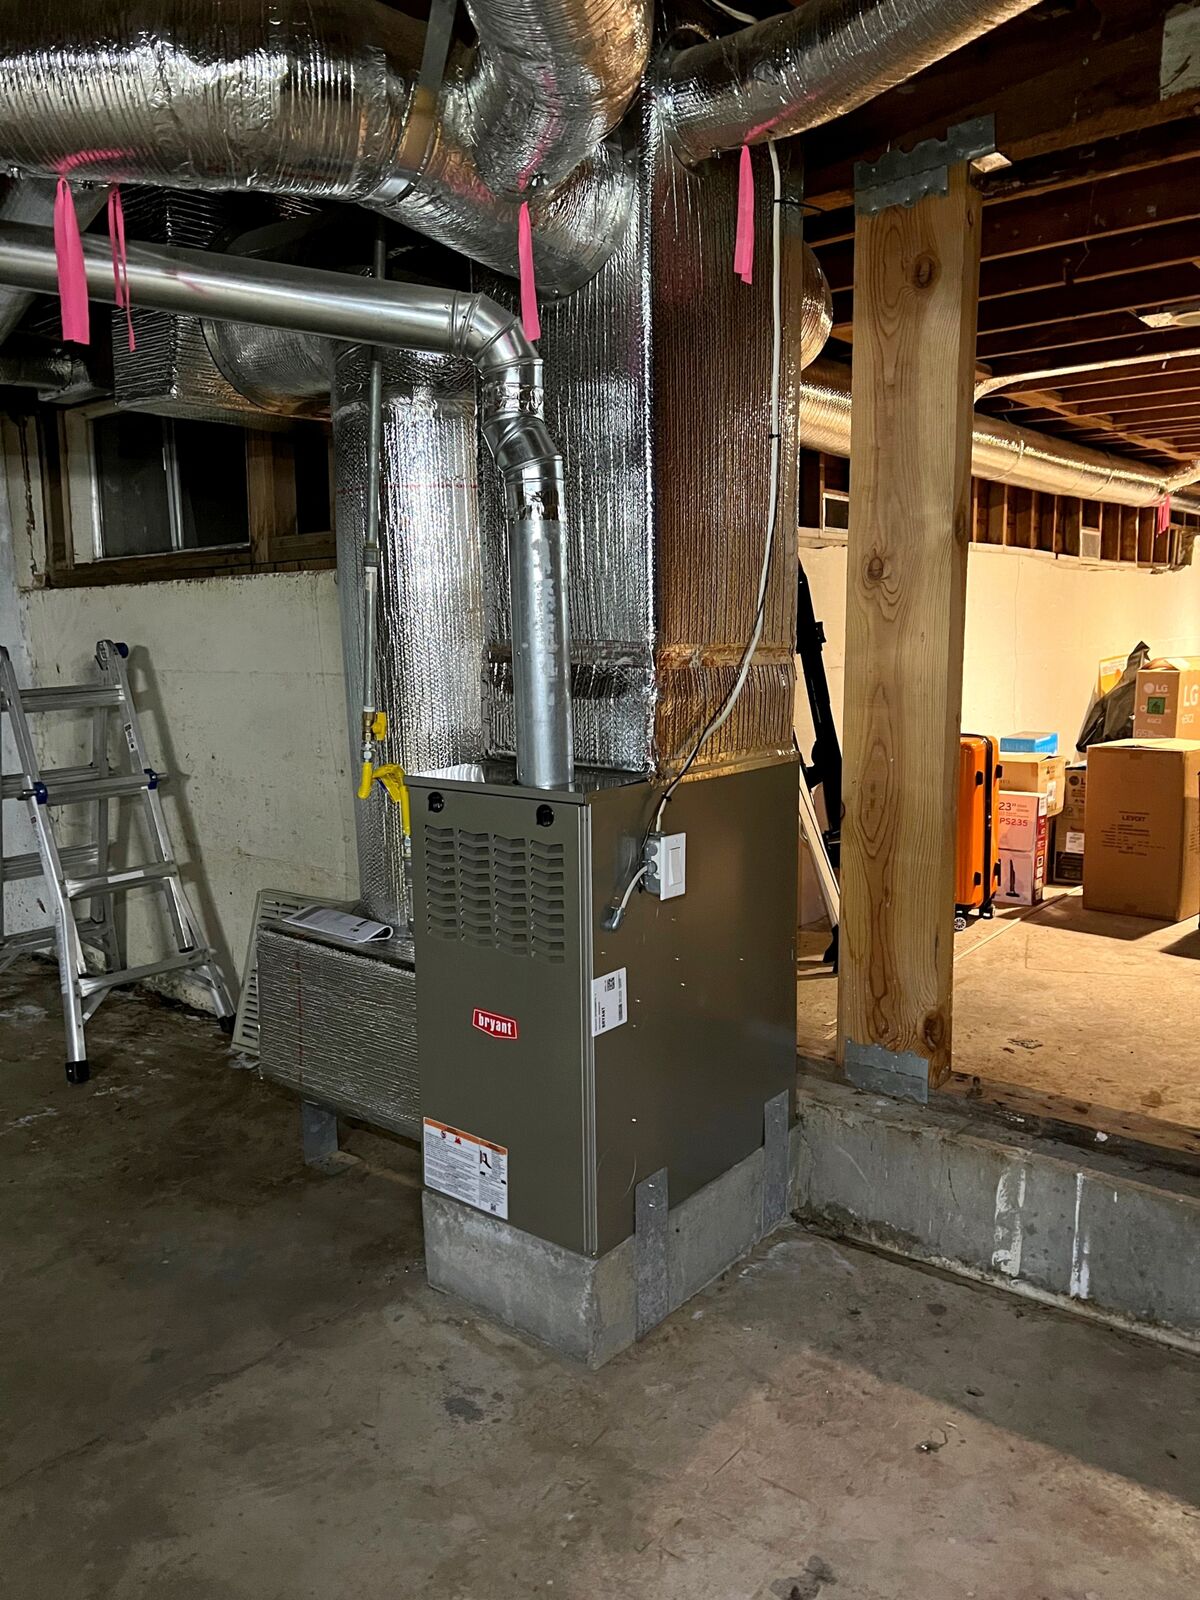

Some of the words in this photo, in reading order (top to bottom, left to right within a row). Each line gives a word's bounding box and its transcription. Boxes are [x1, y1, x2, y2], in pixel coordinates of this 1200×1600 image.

[1155, 684, 1169, 693] LG
[1183, 684, 1200, 707] LG
[999, 817, 1028, 827] PS235
[478, 1012, 512, 1036] bryant
